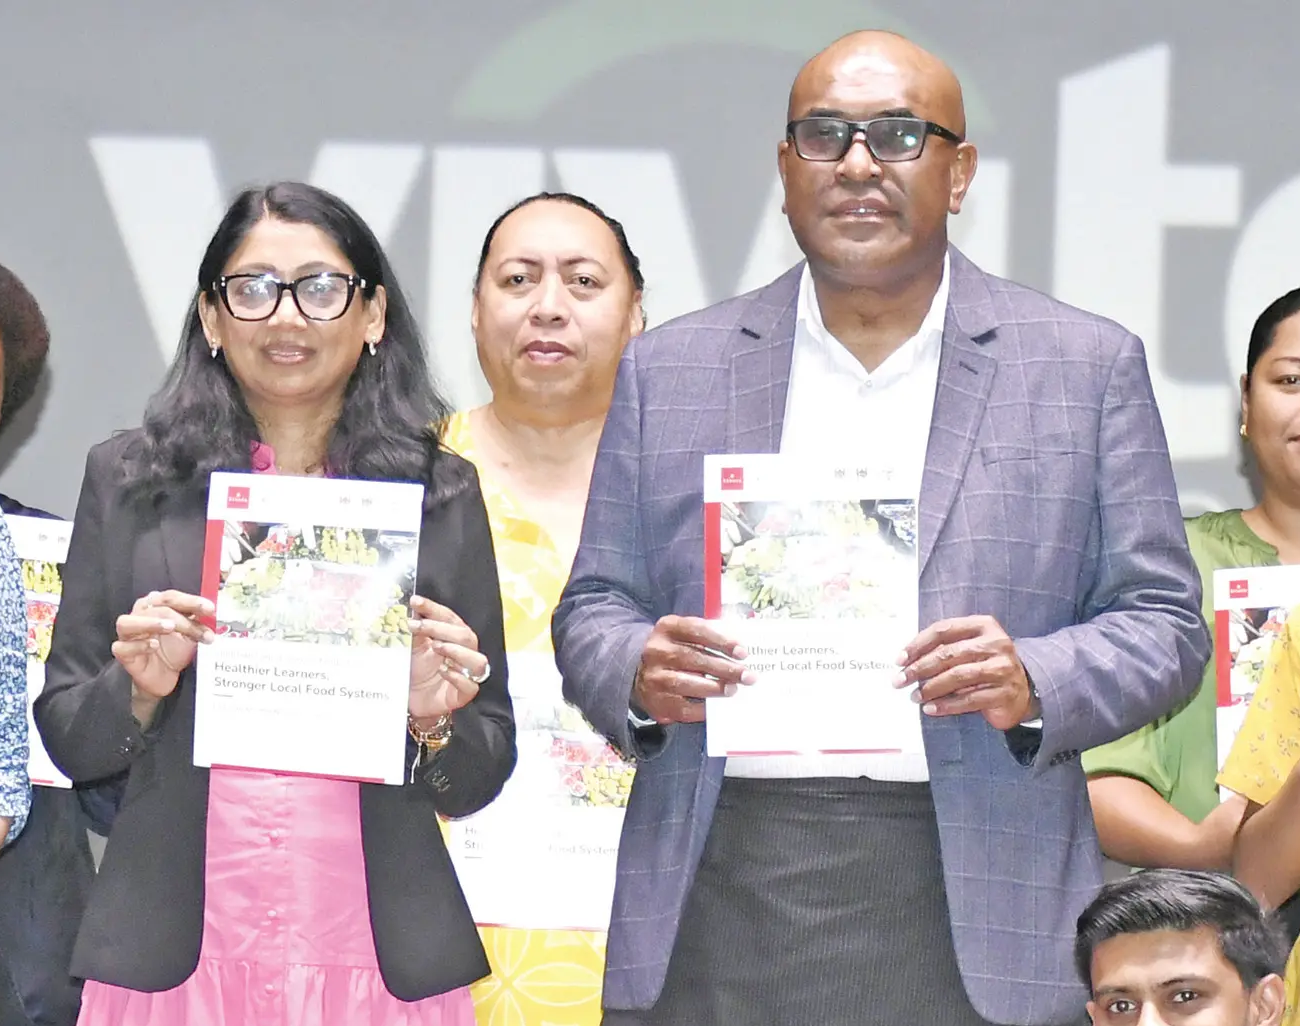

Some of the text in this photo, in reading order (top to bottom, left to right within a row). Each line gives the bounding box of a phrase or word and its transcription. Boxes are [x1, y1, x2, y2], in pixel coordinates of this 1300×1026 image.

[746, 645, 778, 657] lthier
[215, 661, 270, 675] Healthier
[779, 660, 813, 672] Local
[815, 659, 846, 671] Food
[848, 659, 894, 672] System
[214, 674, 390, 700] Stronger Local Food Systems
[579, 845, 618, 855] System
